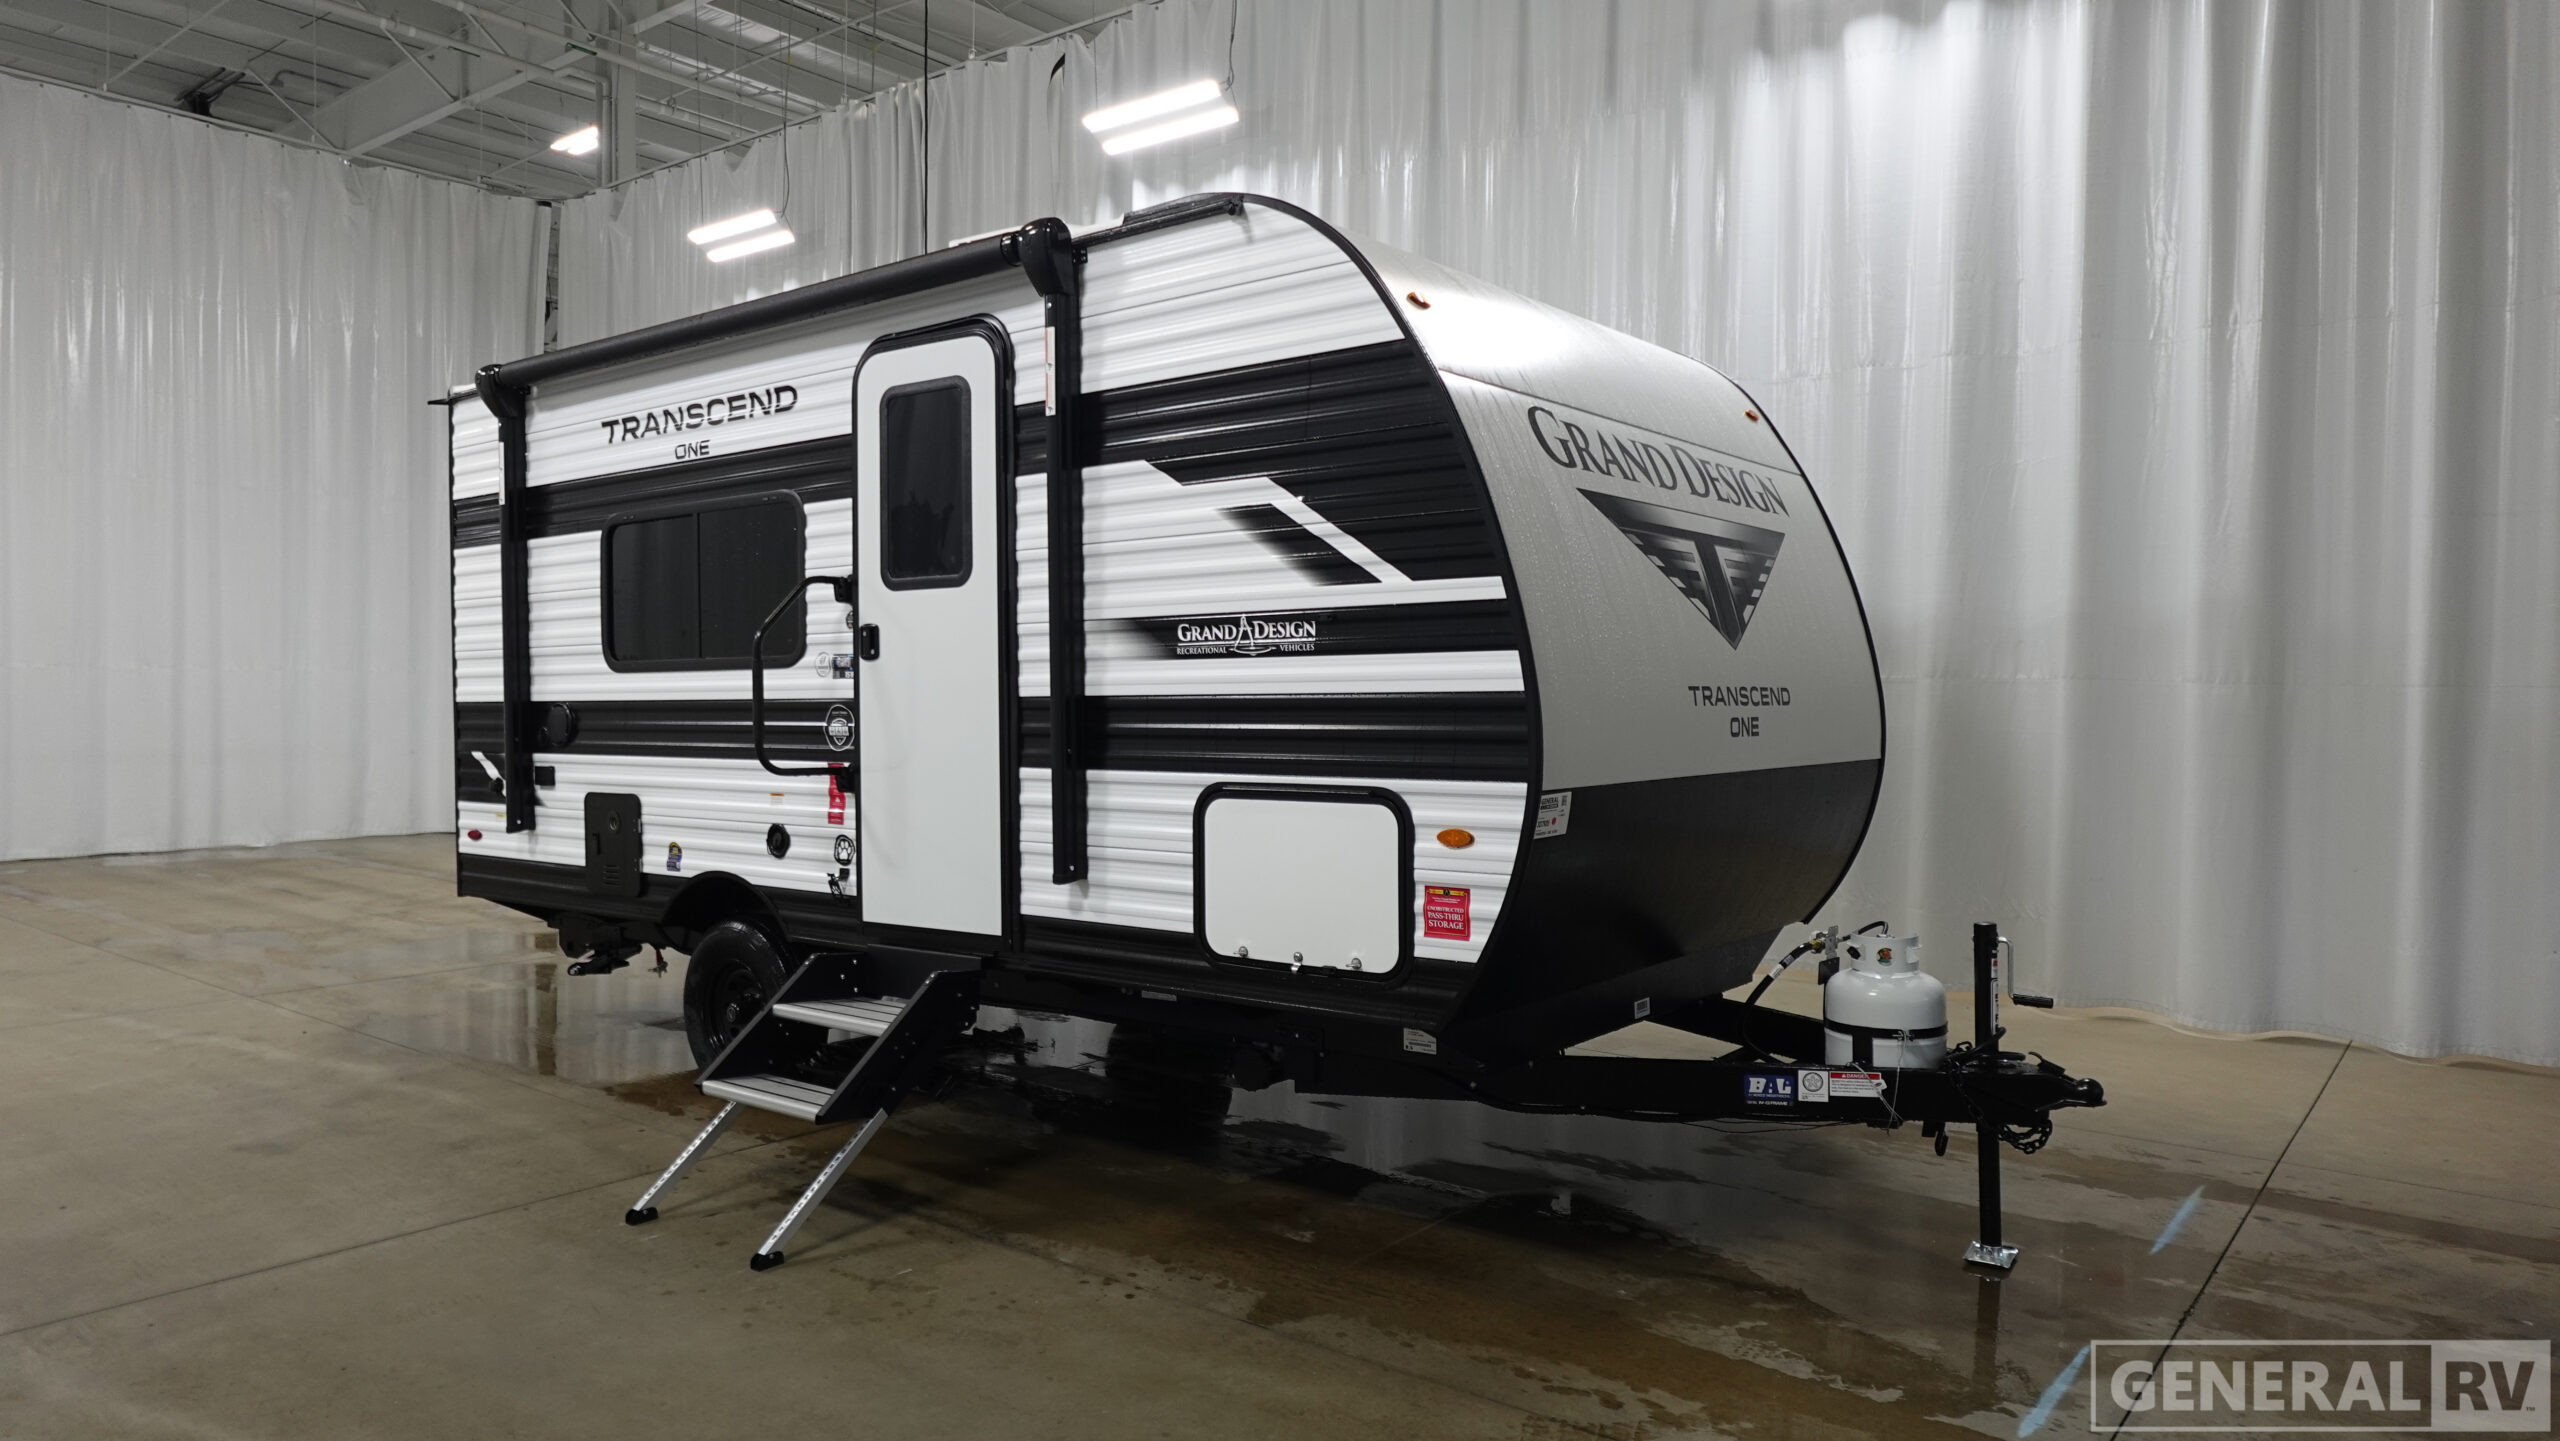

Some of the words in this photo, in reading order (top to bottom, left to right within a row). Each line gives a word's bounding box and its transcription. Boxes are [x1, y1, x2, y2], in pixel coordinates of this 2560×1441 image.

[601, 385, 798, 444] TRANSCEND
[674, 439, 710, 460] ONE
[1527, 406, 1678, 492] GRAND
[1665, 443, 1790, 517] DESIGN
[1177, 623, 1237, 642] GRAND
[1252, 620, 1316, 639] DESIGN
[1177, 646, 1227, 655] RECREATIONAL
[1280, 643, 1315, 652] VEHICLES
[1688, 686, 1791, 706] TRANSCEND
[1730, 716, 1760, 737] ONE
[1427, 911, 1464, 921] PASS-THRU
[1428, 920, 1464, 930] STORAGE
[1749, 1077, 1791, 1094] BAL
